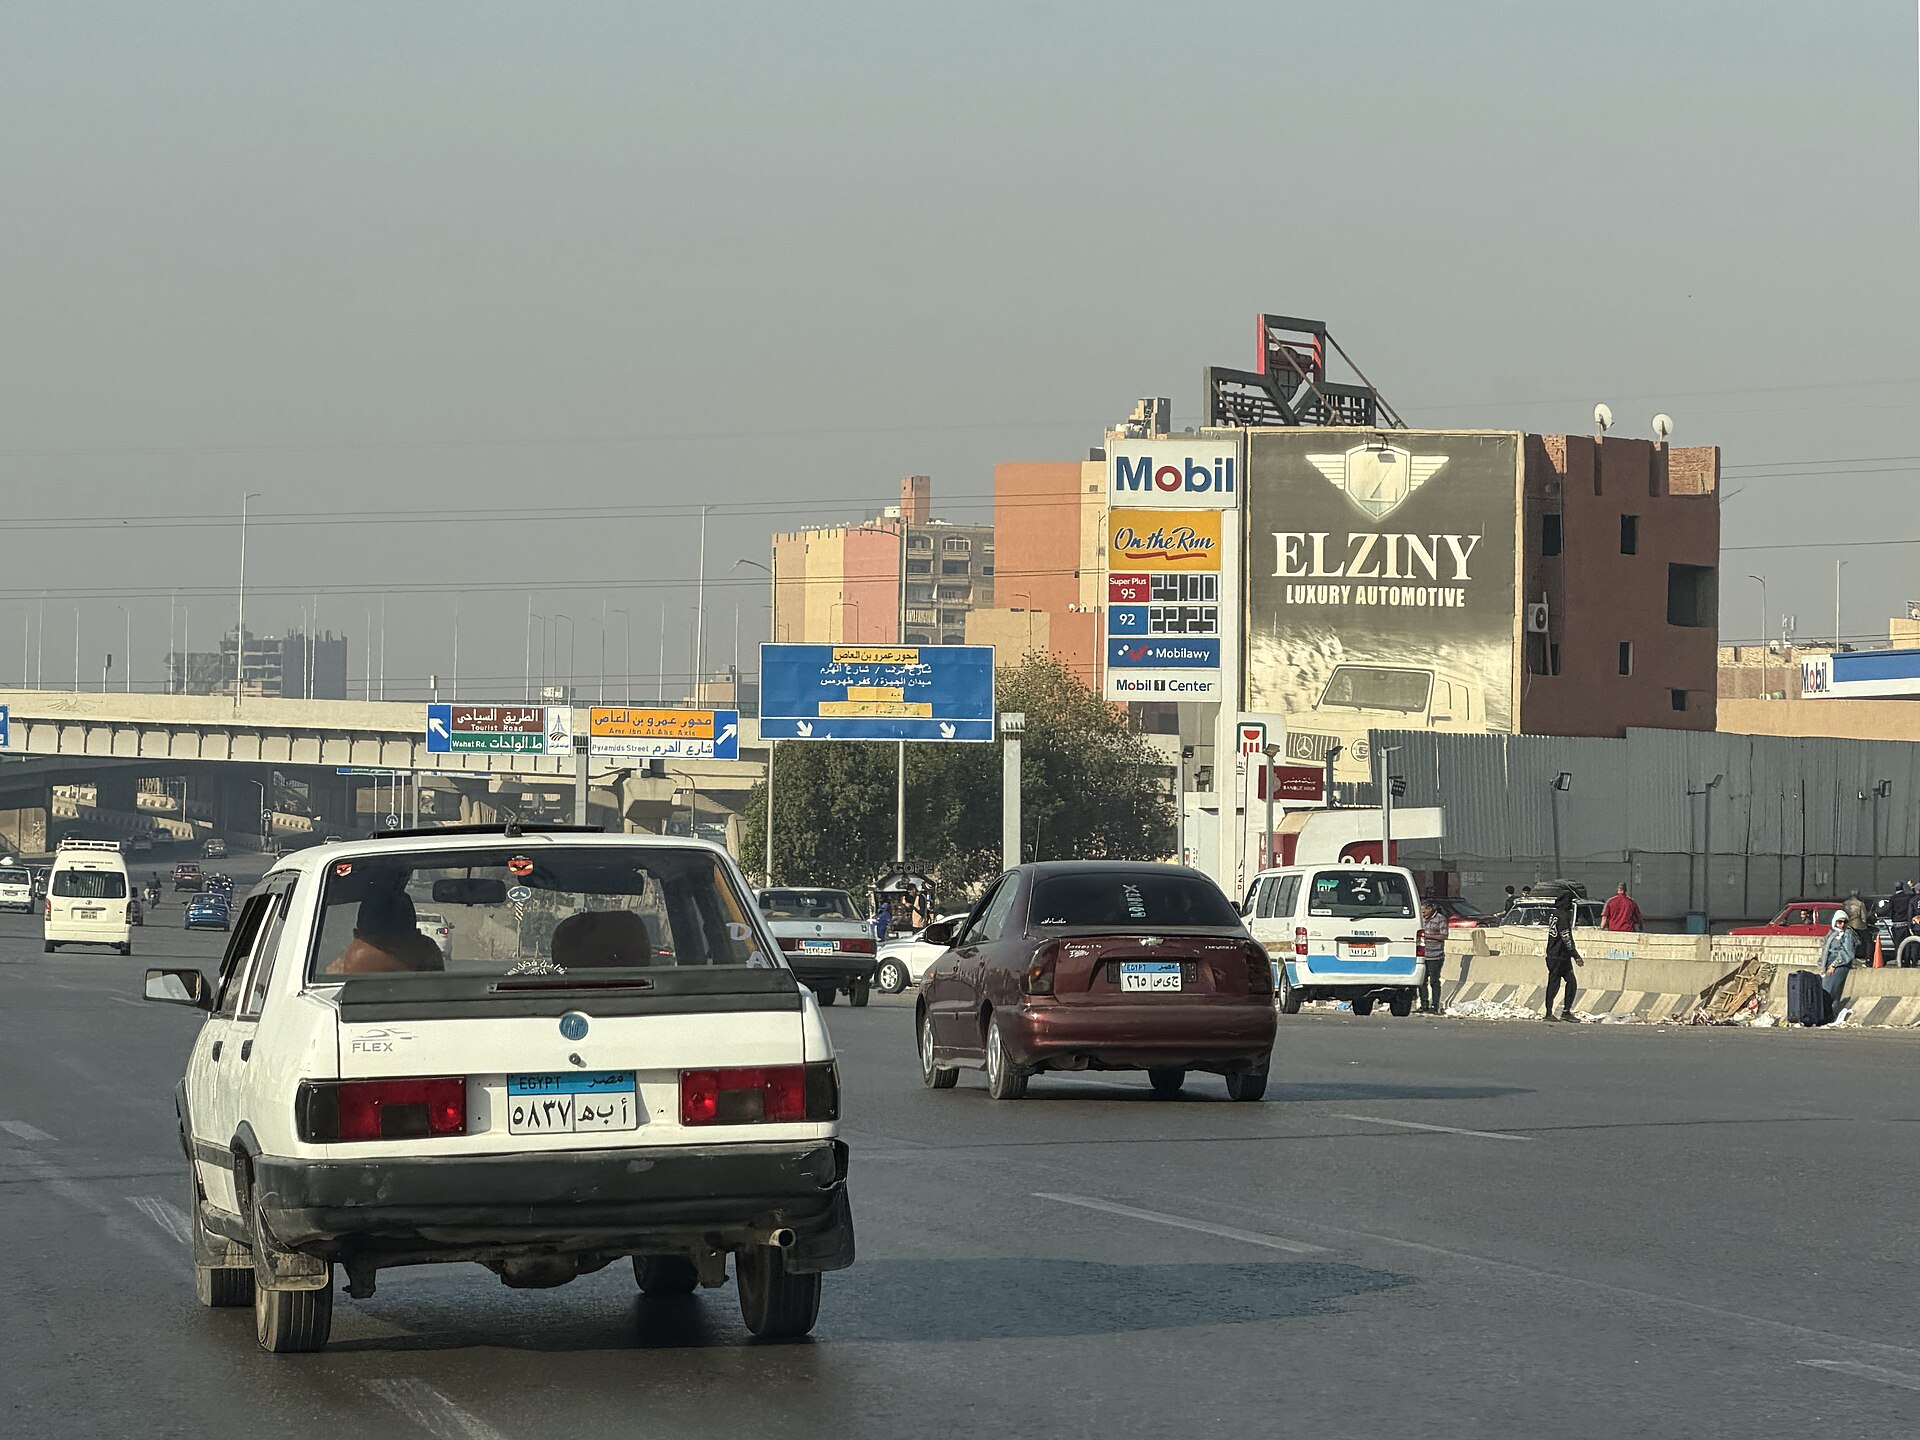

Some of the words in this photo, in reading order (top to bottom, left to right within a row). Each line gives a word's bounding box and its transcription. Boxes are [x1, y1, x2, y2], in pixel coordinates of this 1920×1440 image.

[1116, 456, 1234, 493] Mobil
[1114, 527, 1146, 551] On
[1146, 527, 1175, 550] the
[1172, 526, 1215, 552] Run
[1271, 532, 1482, 581] ELZINY
[1109, 577, 1131, 586] Super
[1131, 577, 1147, 585] Plus
[1151, 574, 1217, 602] 24.00
[1120, 588, 1136, 599] 95
[1286, 584, 1352, 605] LUXURY
[1355, 585, 1466, 608] AUTOMOTIVE
[1119, 613, 1136, 626] 92
[1150, 606, 1217, 634] 22.25
[833, 650, 861, 661] العاص
[860, 651, 872, 662] بن
[873, 652, 894, 662] عمرو
[893, 652, 918, 662] محور
[1156, 647, 1210, 662] Mobilawy
[845, 664, 870, 675] شارع
[1802, 661, 1828, 691] Mobil
[880, 676, 906, 688] الجيزة
[908, 678, 932, 688] ميدان
[1116, 679, 1151, 691] Mobil
[1168, 680, 1212, 692] Center
[502, 708, 539, 725] الطريق
[594, 709, 630, 726] العاص
[632, 717, 644, 727] بن
[647, 717, 677, 728] عمرو
[470, 723, 498, 732] Tourist
[503, 724, 524, 732] Road
[680, 718, 712, 729] محور
[475, 740, 487, 748] Rd.
[592, 744, 625, 753] Pyramids
[626, 744, 649, 752] Street
[652, 741, 681, 756] الهرم
[686, 741, 713, 756] شارع
[1127, 974, 1147, 989] ٢٦٥
[352, 1041, 393, 1054] FLEX
[519, 1075, 562, 1090] EGYPT
[587, 1074, 624, 1088] مصر
[512, 1099, 571, 1128] ٥٨٣٧
